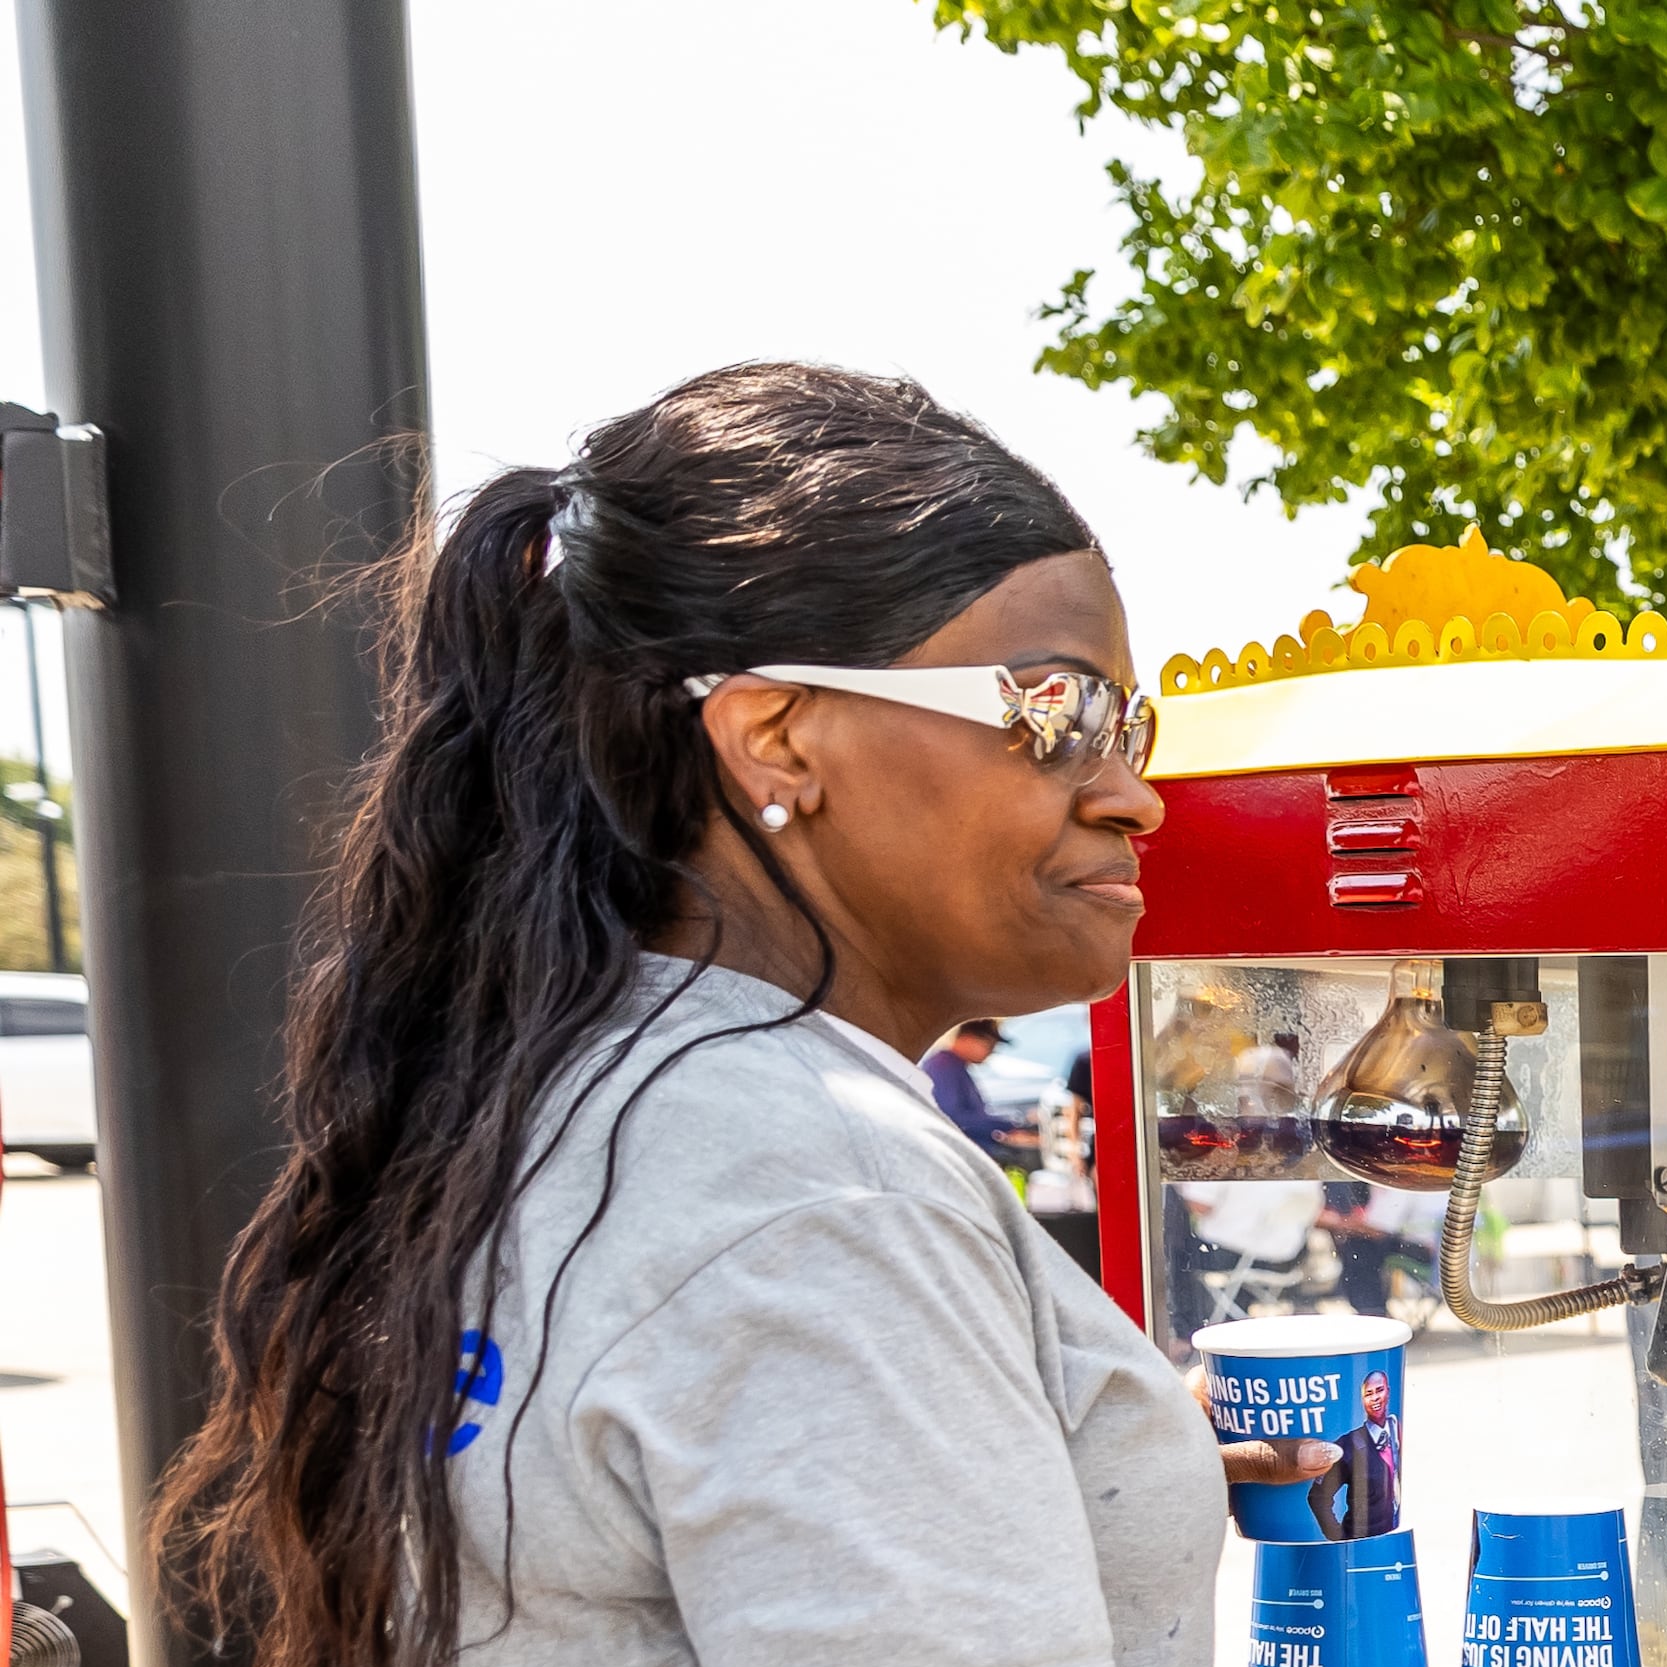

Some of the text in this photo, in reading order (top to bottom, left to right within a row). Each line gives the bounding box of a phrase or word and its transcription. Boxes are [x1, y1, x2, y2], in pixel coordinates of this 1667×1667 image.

[1245, 1378, 1270, 1405] IS
[1275, 1373, 1341, 1405] JUST
[1261, 1408, 1294, 1436] OF
[1301, 1407, 1326, 1435] IT
[1577, 1598, 1601, 1608] pace
[1286, 1626, 1312, 1635] pace
[1477, 1615, 1501, 1641] OF
[1505, 1616, 1566, 1641] HALF
[1572, 1616, 1613, 1641] THE
[1250, 1639, 1276, 1667] HAL
